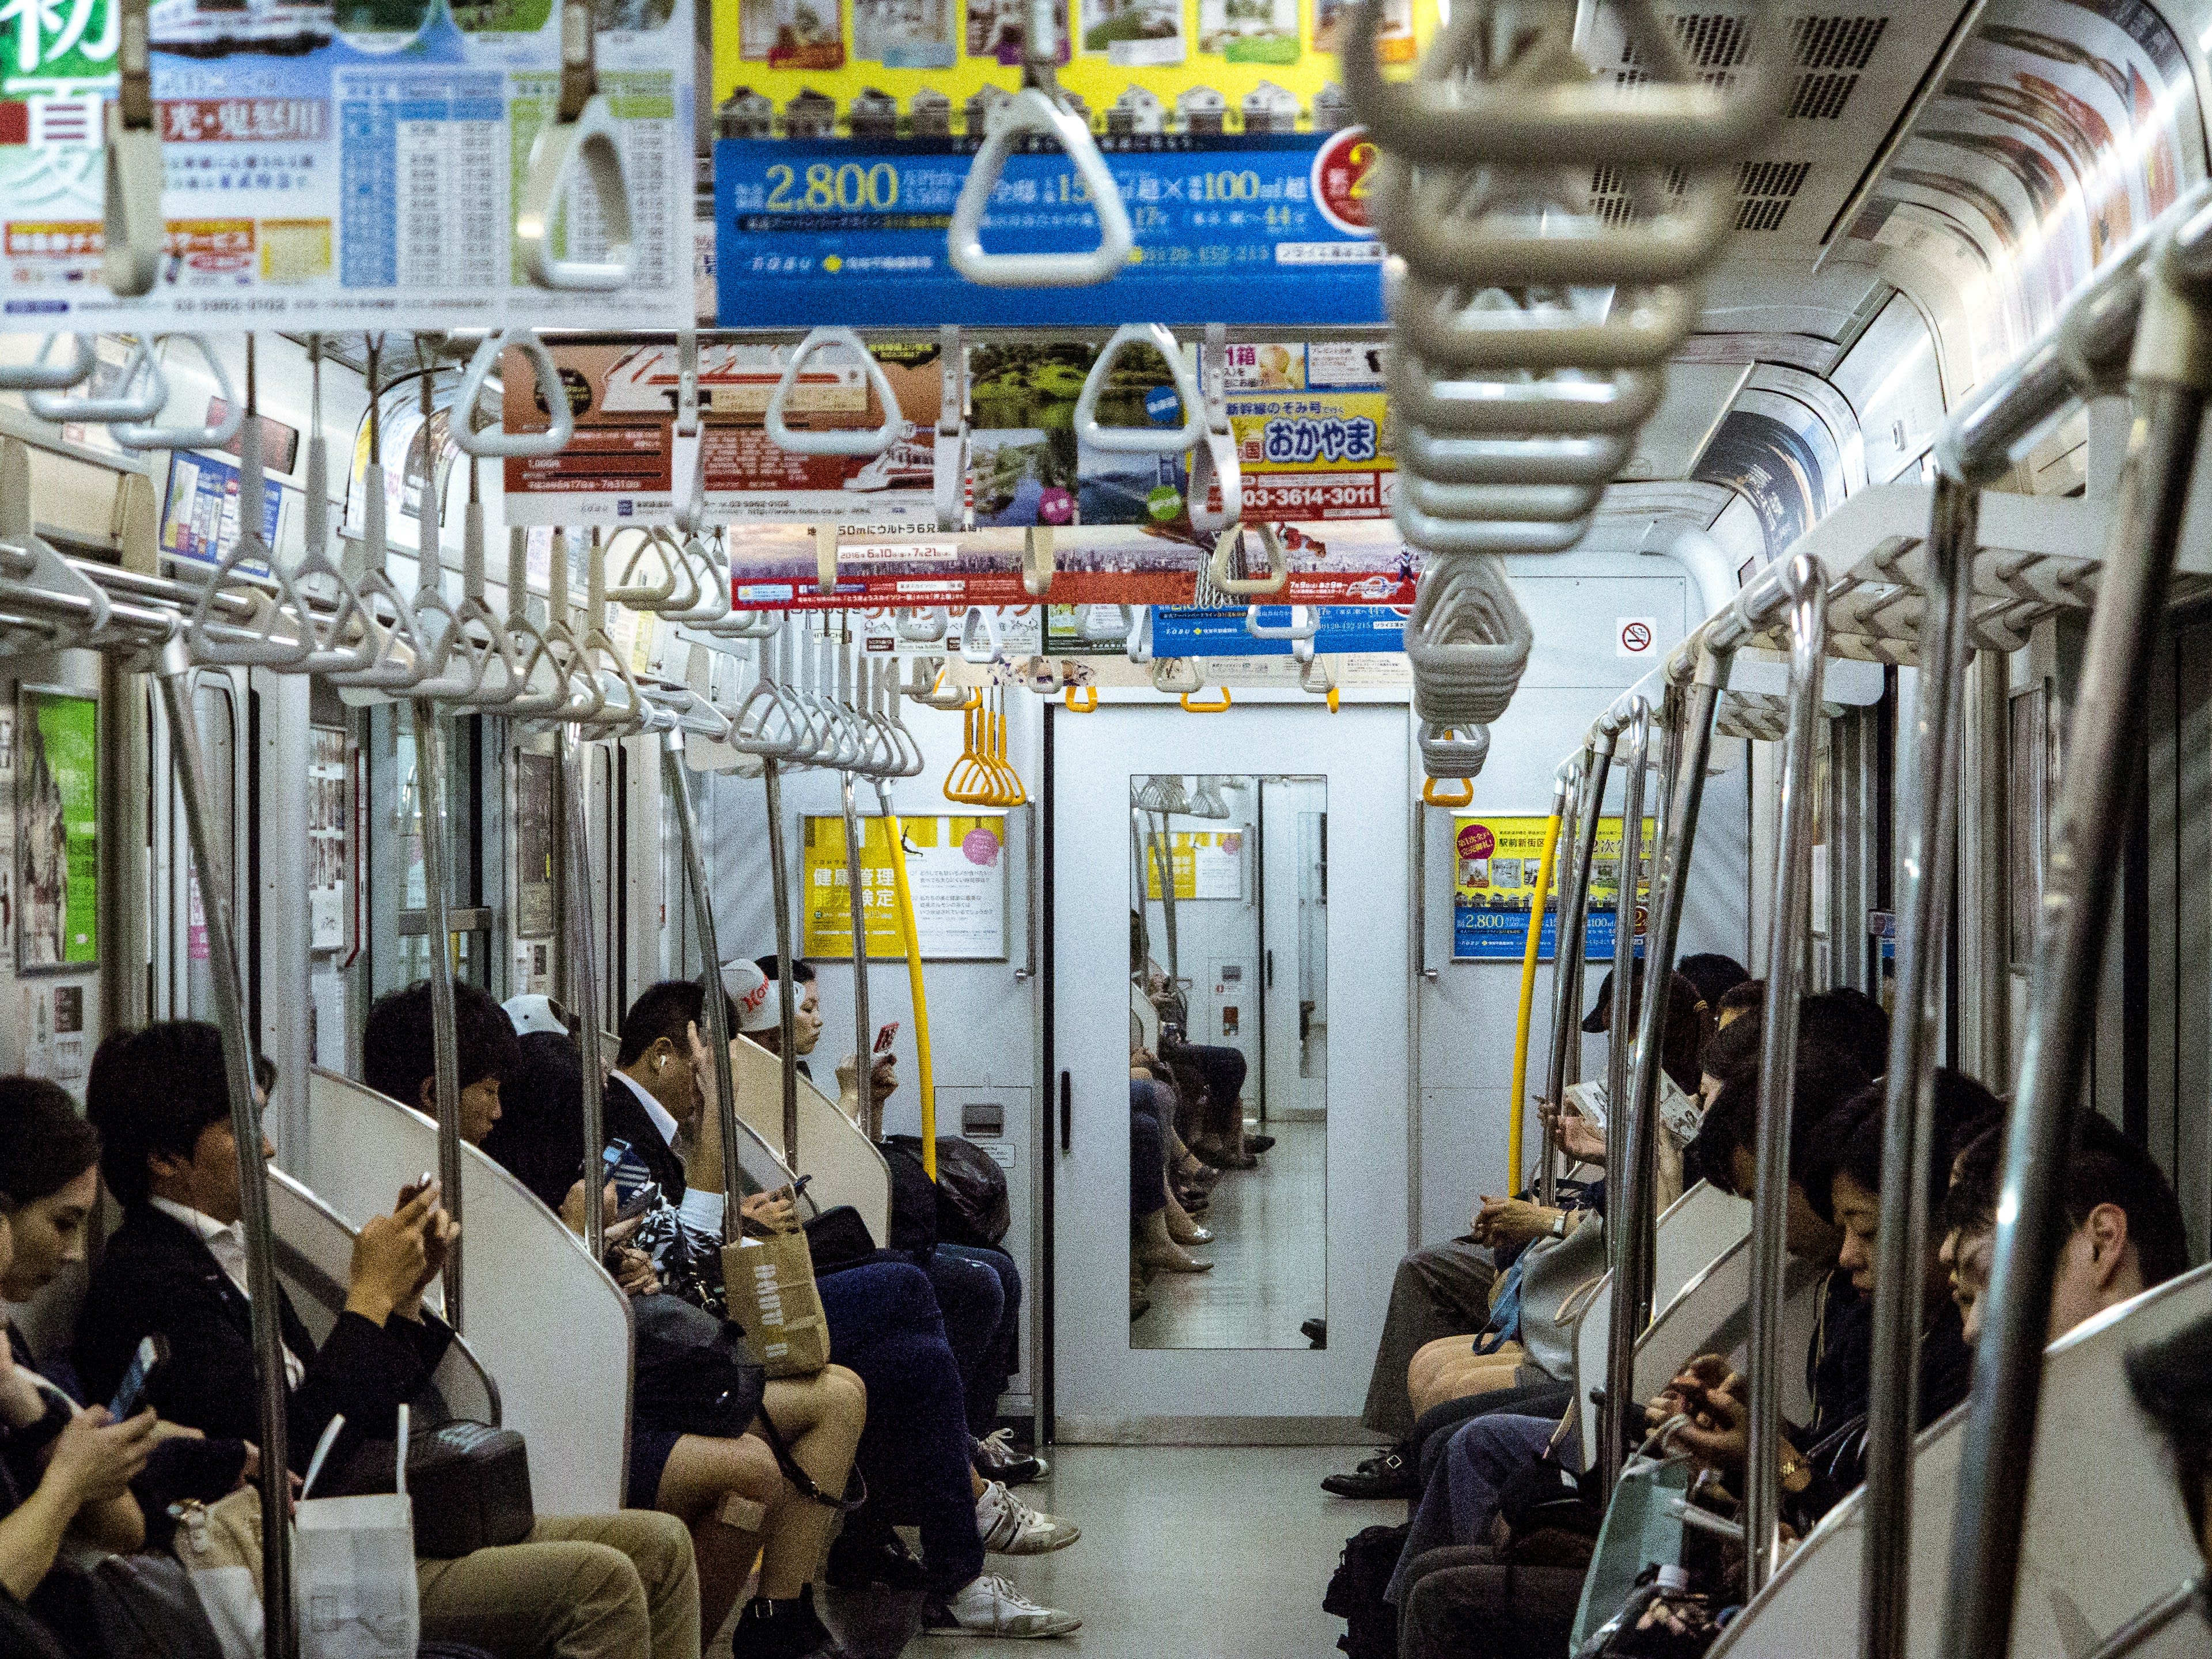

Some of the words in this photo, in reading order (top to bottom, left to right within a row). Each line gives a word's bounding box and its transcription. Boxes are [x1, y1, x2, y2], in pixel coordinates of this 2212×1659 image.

[1270, 422, 1370, 456] おかやま
[1243, 488, 1375, 506] 03-3614-3011
[1499, 838, 1545, 847] 駅前新街区
[813, 868, 895, 887] 健康管理
[813, 889, 895, 908] 能力検定
[1465, 914, 1504, 928] 2,800
